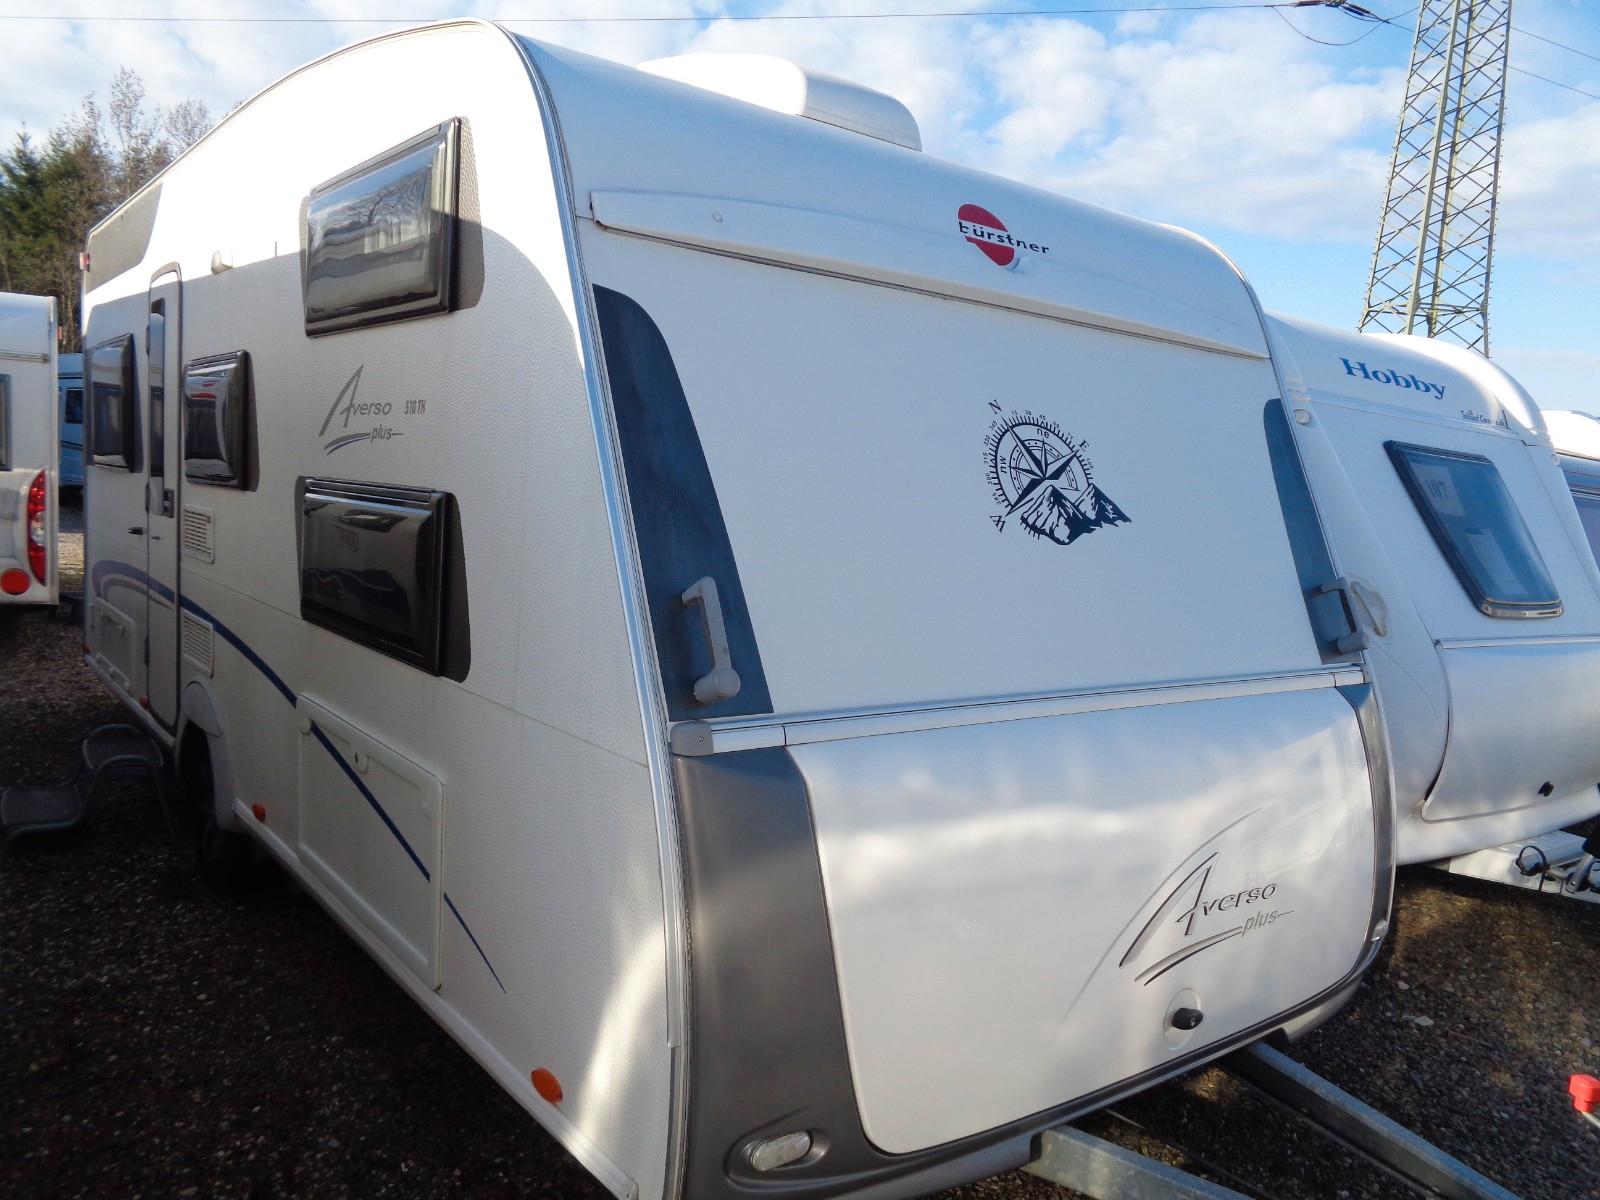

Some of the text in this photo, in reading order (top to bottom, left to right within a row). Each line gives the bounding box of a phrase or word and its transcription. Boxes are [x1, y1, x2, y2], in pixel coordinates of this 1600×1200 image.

[958, 221, 1050, 254] bürstner
[1338, 357, 1446, 400] Hobby
[319, 364, 392, 437] Averso
[988, 400, 1002, 414] N
[370, 424, 393, 443] plus
[1078, 439, 1089, 452] E
[1119, 851, 1278, 969] Averso
[1242, 911, 1279, 939] plus
